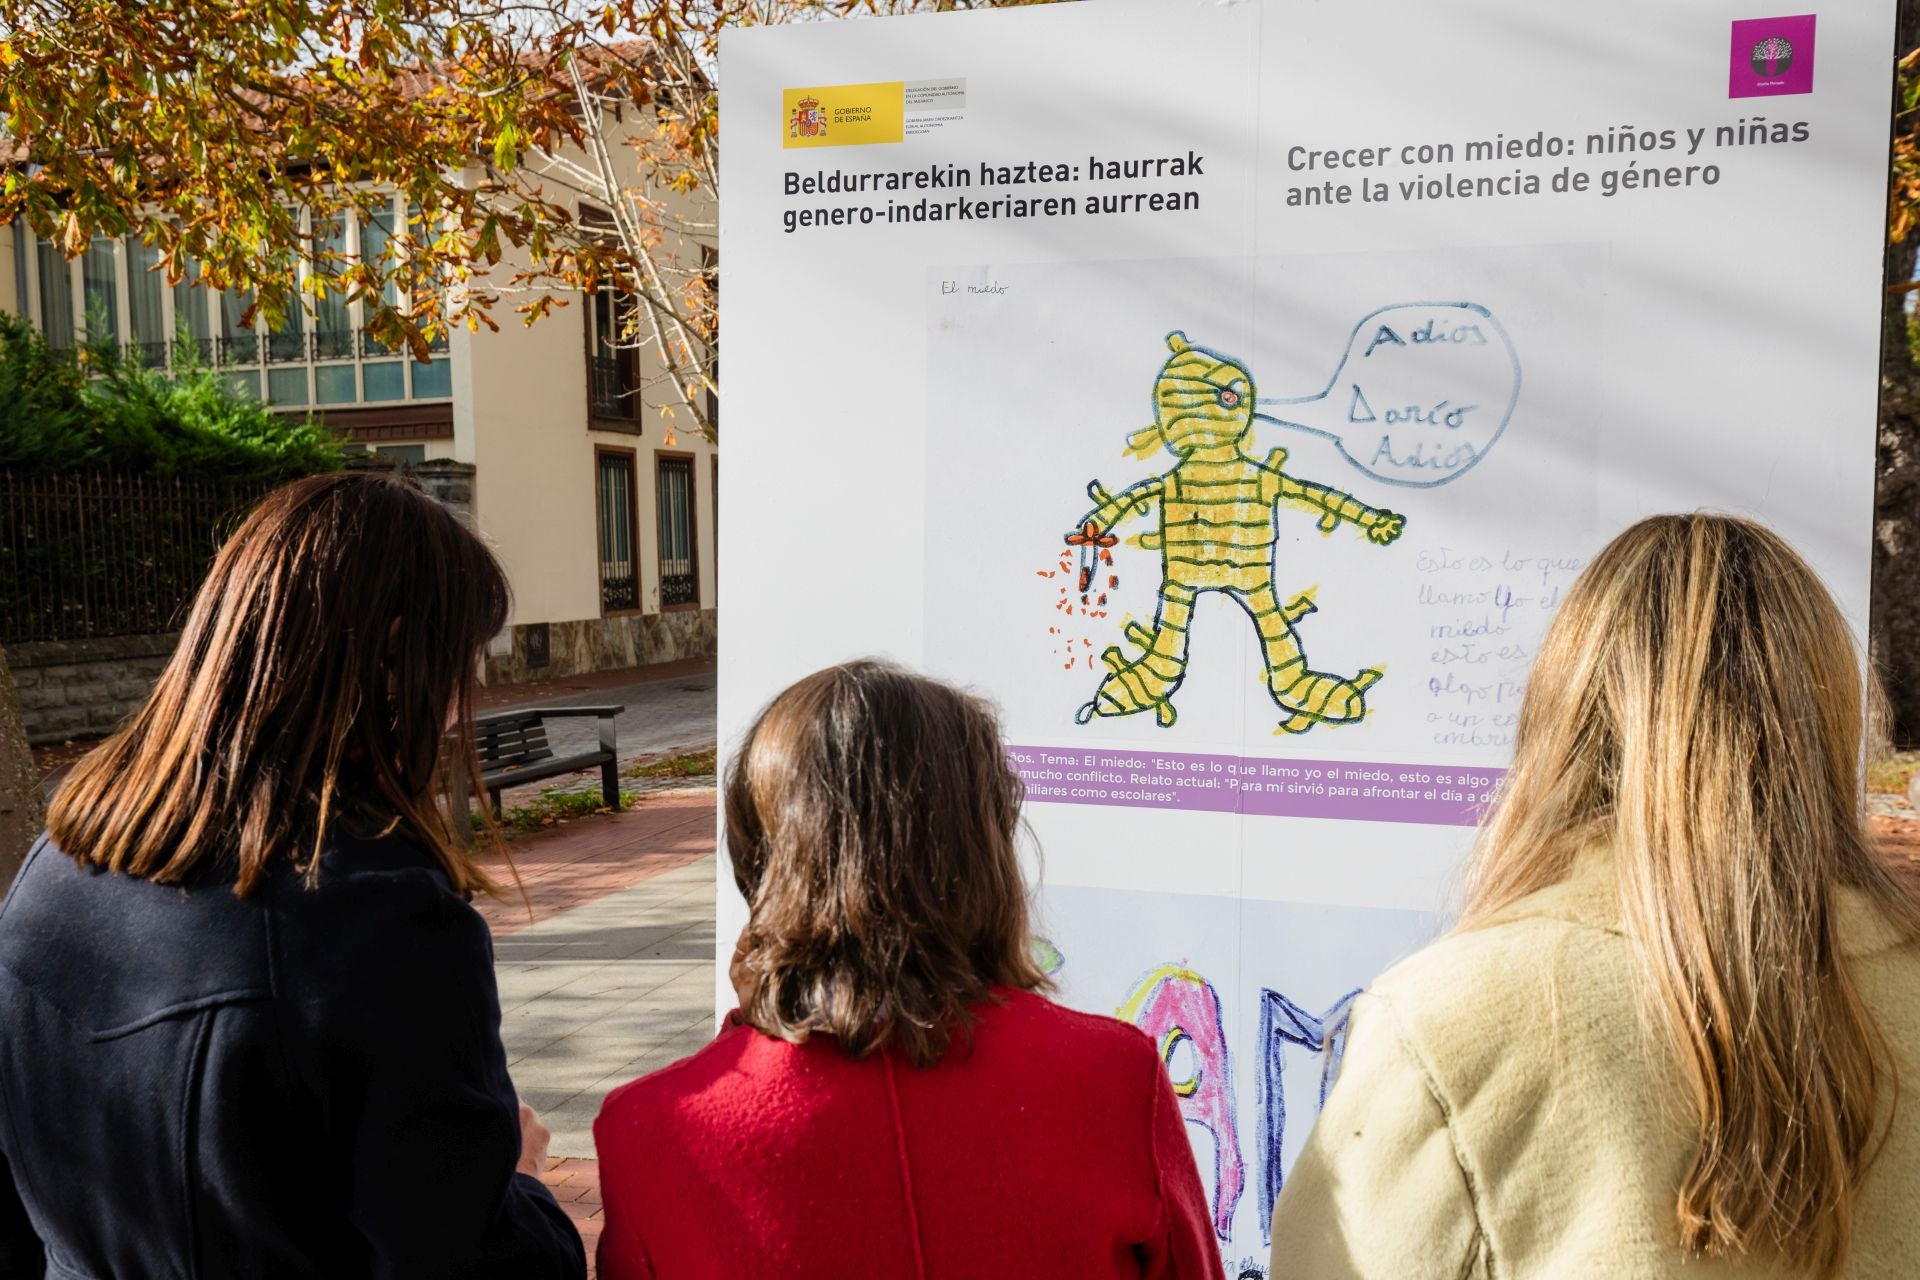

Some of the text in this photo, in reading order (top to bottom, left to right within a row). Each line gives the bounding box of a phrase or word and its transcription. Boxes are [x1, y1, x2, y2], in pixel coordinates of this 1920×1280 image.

[834, 106, 872, 116] GOBIERNO
[834, 113, 872, 123] DE ESPAÑA
[1287, 116, 1810, 171] Crecer con miedo: niños y niñas
[784, 151, 1204, 196] Beldurrarekin haztea: haurrak
[1286, 160, 1721, 207] ante la violencia de género
[783, 191, 1200, 234] genero-indarkeriaren aurrean
[941, 280, 1010, 295] El miedo
[1364, 318, 1488, 357] Adios
[1371, 434, 1478, 469] Adios
[1416, 547, 1584, 586] Esto es lo que
[1418, 583, 1488, 606] llamo
[1430, 616, 1512, 639] miedo
[1431, 643, 1528, 665] esto es
[1005, 751, 1035, 764] ños.
[1040, 753, 1079, 767] Tema:
[1084, 755, 1096, 767] El
[1101, 756, 1146, 769] miedo:
[1151, 758, 1185, 771] "Esto
[1190, 761, 1206, 773] es
[1210, 760, 1222, 773] lo
[1227, 763, 1257, 776] que
[1262, 764, 1300, 778] llamo
[1305, 768, 1322, 781] yo
[1327, 767, 1339, 780] el
[1344, 768, 1394, 783] miedo,
[1399, 772, 1431, 784] esto
[1436, 773, 1452, 785] es
[1457, 774, 1489, 789] algo
[1019, 767, 1063, 781] mucho
[1066, 769, 1126, 784] conflicto.
[1130, 772, 1173, 786] Relato
[1176, 776, 1221, 789] actual:
[1224, 778, 1263, 793] "Para
[1266, 780, 1284, 793] mí
[1287, 781, 1324, 795] sirvió
[1328, 785, 1359, 798] para
[1363, 784, 1420, 800] afrontar
[1424, 788, 1437, 801] el
[1441, 788, 1463, 802] día
[1467, 792, 1476, 802] a
[1070, 785, 1107, 798] como
[1111, 788, 1181, 803] escolares".
